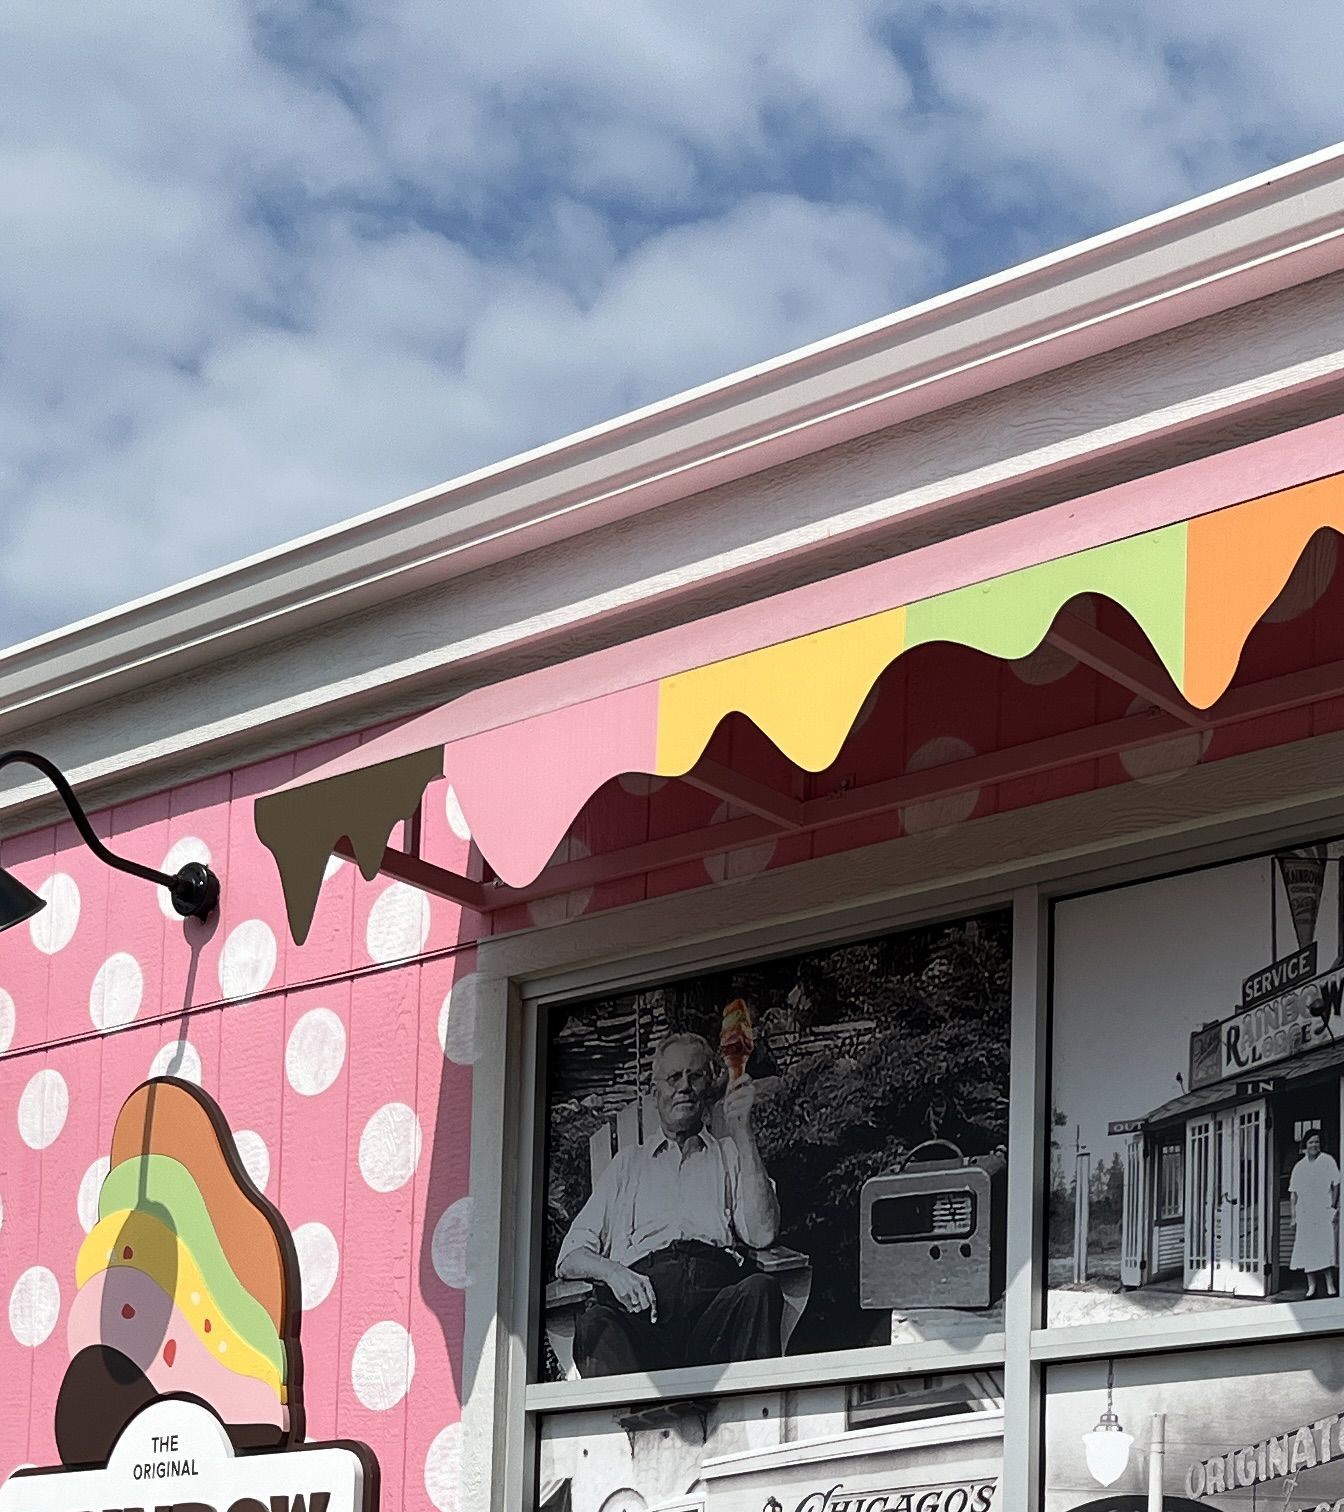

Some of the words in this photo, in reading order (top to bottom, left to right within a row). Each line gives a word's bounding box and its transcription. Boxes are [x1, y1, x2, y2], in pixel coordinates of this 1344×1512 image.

[1245, 951, 1312, 1001] SERVICE
[1247, 1080, 1275, 1095] IN
[1113, 1121, 1145, 1132] OUT
[151, 1435, 179, 1453] THE
[133, 1459, 199, 1480] ORIGINAL
